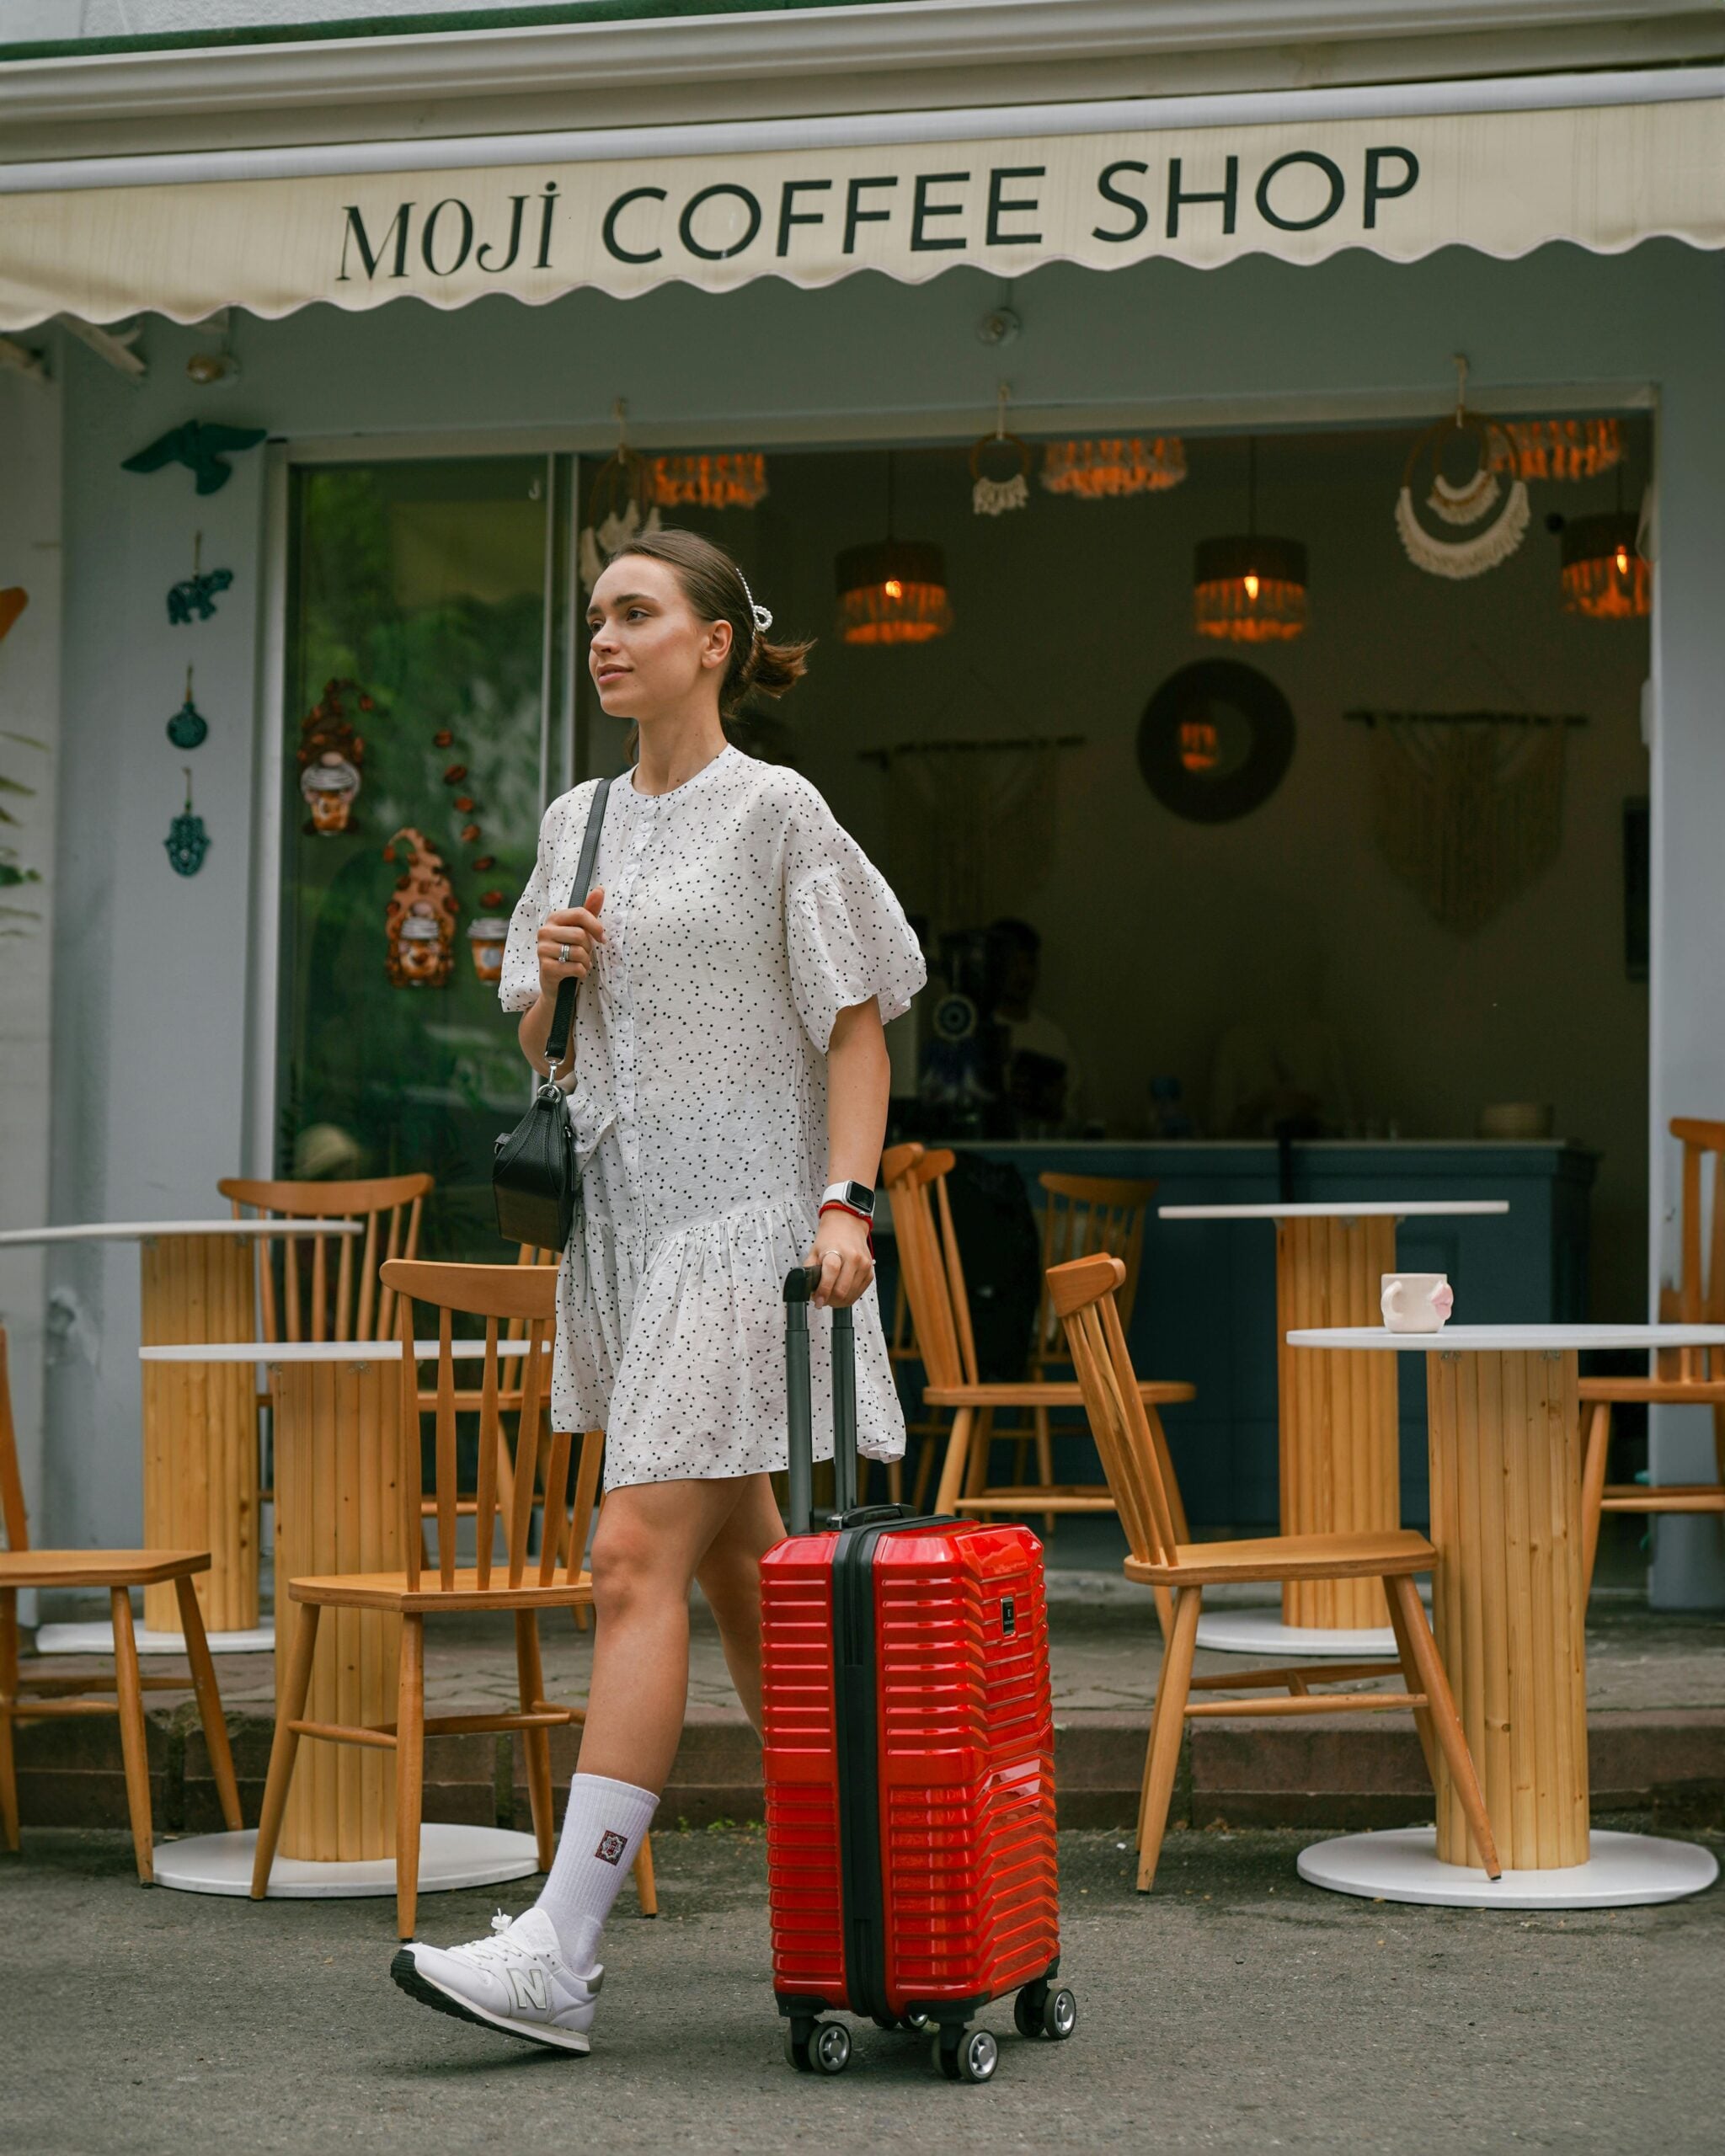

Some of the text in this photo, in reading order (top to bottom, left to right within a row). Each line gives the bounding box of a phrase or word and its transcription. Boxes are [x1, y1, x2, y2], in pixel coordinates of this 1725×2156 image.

[602, 166, 1046, 264] COFFEE
[1091, 146, 1420, 243] SHOP
[506, 1967, 547, 2010] N
